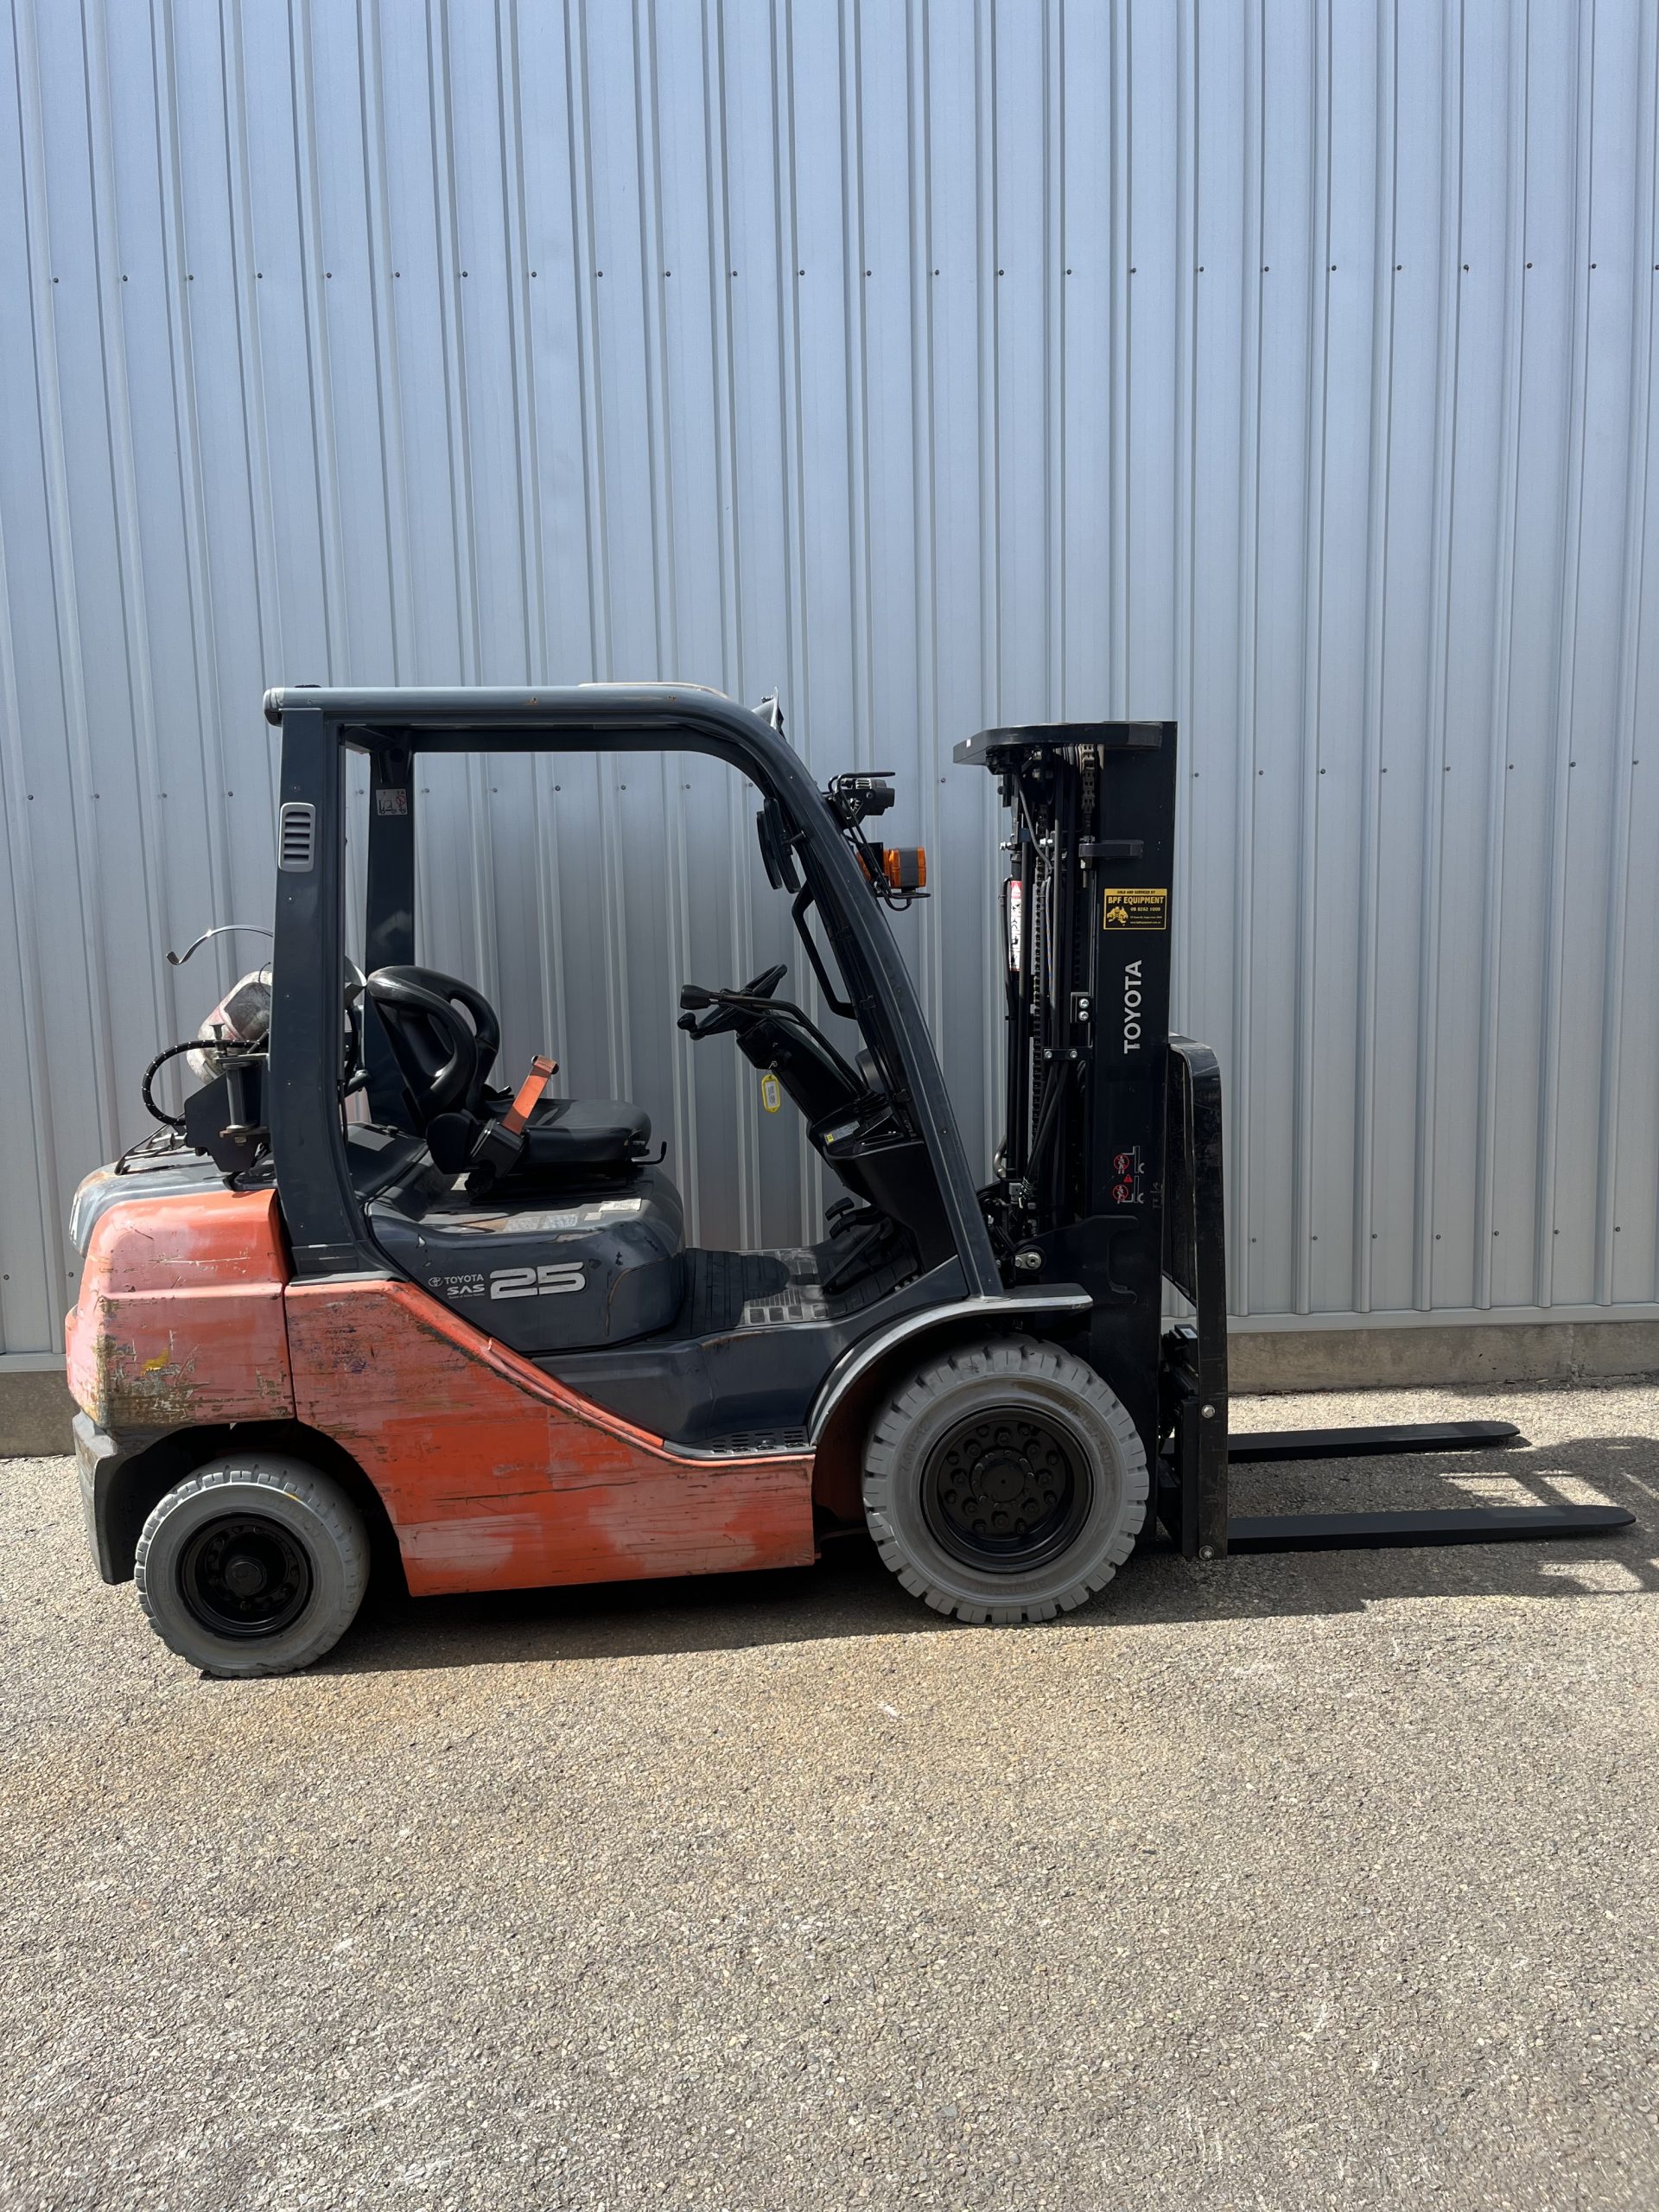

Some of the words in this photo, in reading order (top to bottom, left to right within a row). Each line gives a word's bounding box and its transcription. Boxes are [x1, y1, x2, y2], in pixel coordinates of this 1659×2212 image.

[1123, 896, 1165, 905] EQUIPMENT
[1123, 959, 1142, 1054] TOYOTA
[444, 1274, 485, 1284] TOYOTA
[490, 1262, 586, 1300] 25
[447, 1283, 486, 1295] SAS
